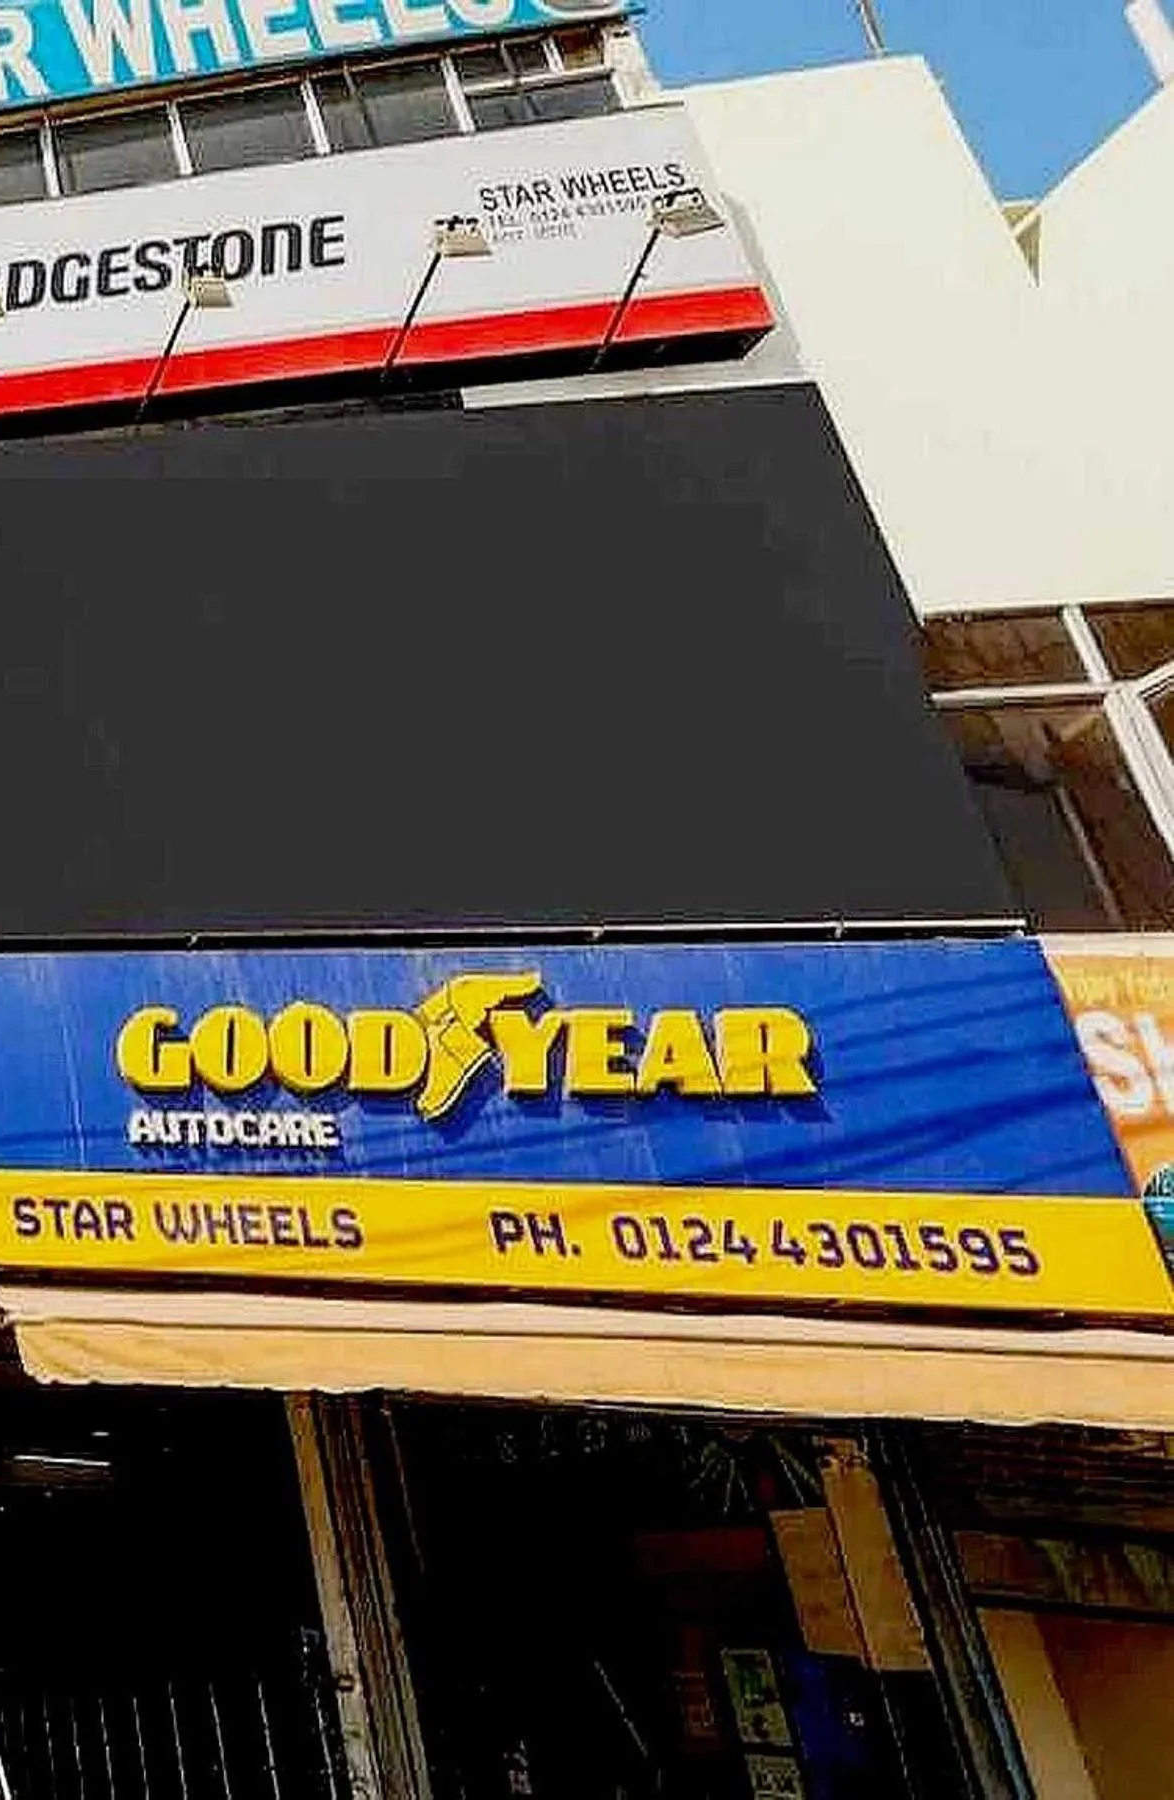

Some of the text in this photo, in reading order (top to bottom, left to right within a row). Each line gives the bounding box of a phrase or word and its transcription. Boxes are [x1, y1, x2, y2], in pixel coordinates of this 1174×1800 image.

[479, 180, 554, 212] STAR
[560, 162, 687, 202] WHEELS
[115, 1001, 819, 1100] GOODYEAR
[127, 1110, 340, 1150] AUTOCARE
[13, 1198, 136, 1243] STAR
[154, 1199, 365, 1251] WHEELS
[490, 1211, 583, 1260] PH.
